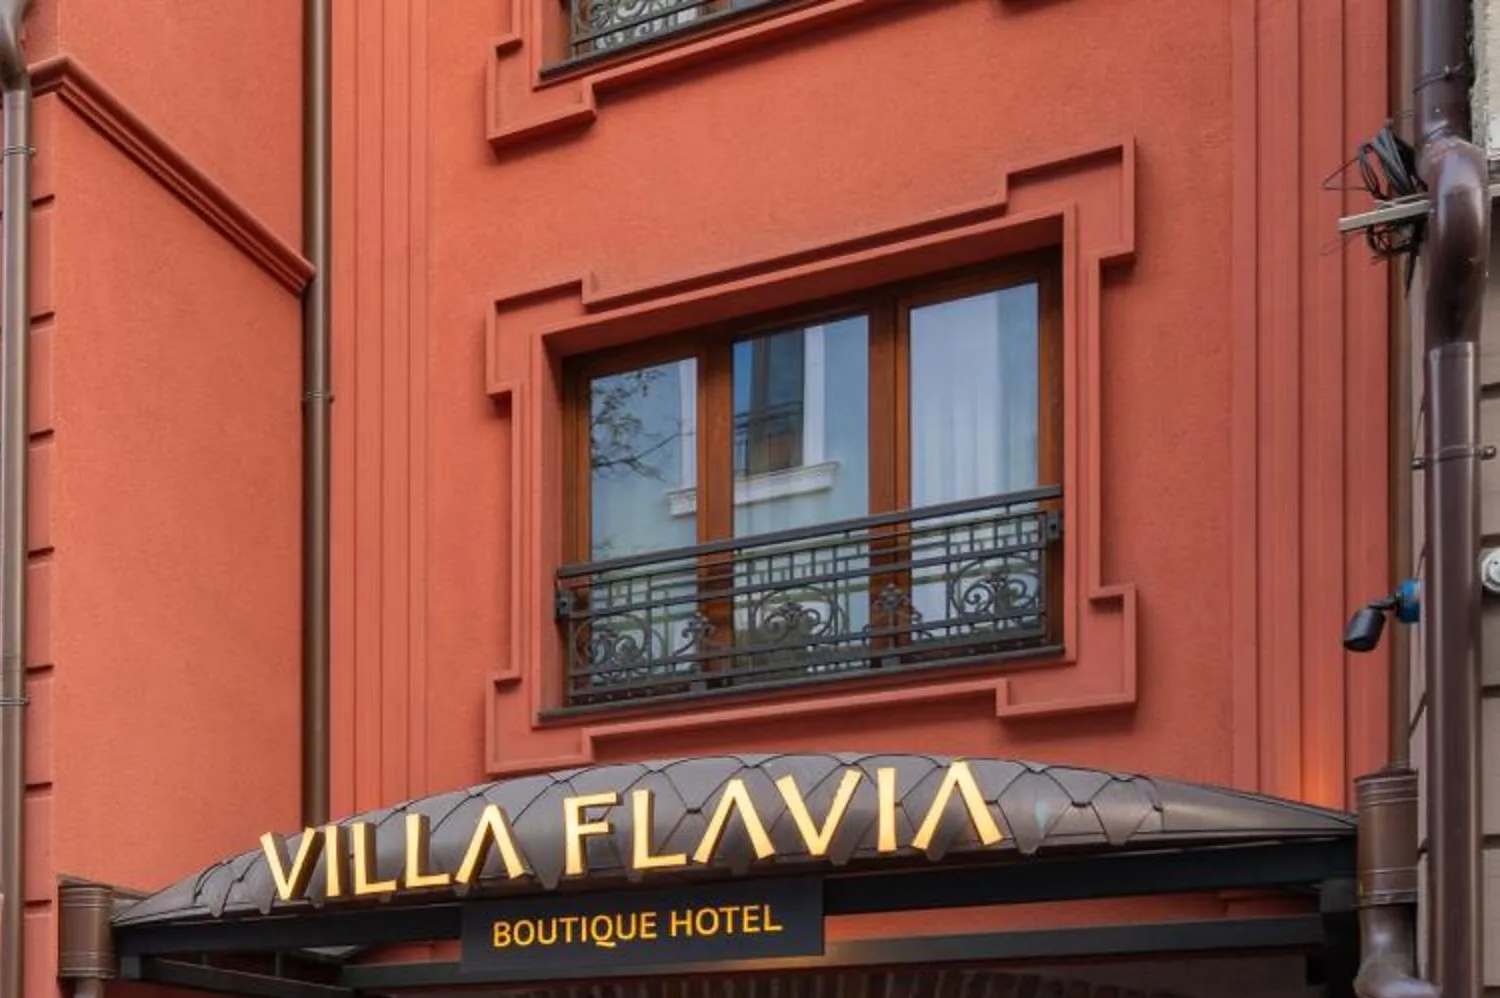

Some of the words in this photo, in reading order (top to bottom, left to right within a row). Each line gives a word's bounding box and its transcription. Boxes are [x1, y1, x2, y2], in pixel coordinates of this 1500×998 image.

[260, 803, 528, 901] VILLA
[563, 761, 1003, 876] FLAVIA
[493, 911, 657, 949] BOUTIQUE
[670, 904, 784, 938] HOTEL
